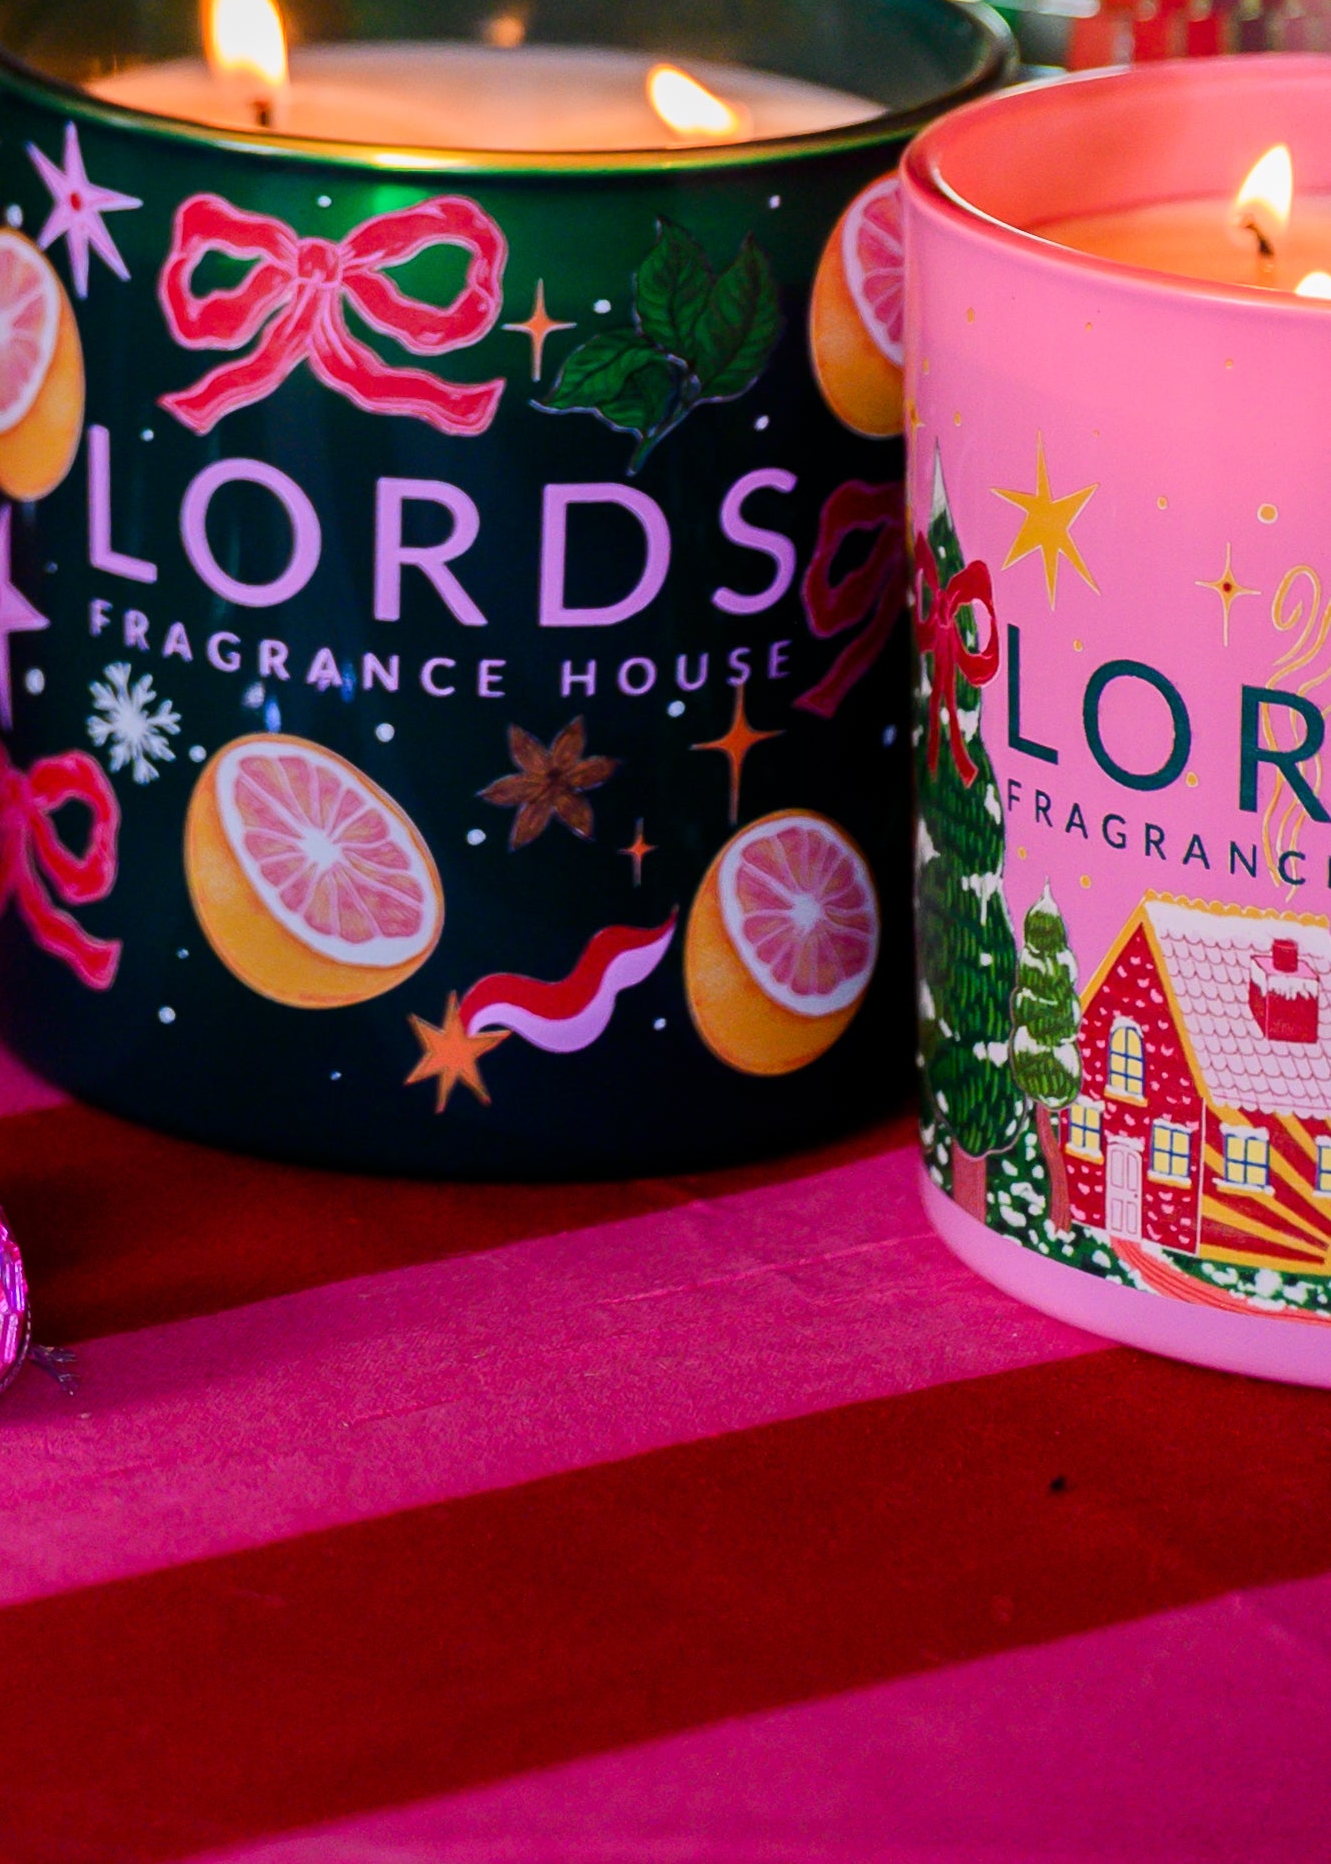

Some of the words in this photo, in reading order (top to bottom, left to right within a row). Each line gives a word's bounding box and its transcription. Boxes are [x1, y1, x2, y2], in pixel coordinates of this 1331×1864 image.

[87, 424, 798, 628] LORDS
[89, 599, 507, 698] FRAGRANCE
[561, 640, 794, 698] HOUSE
[1008, 778, 1331, 889] FRAGRANC
